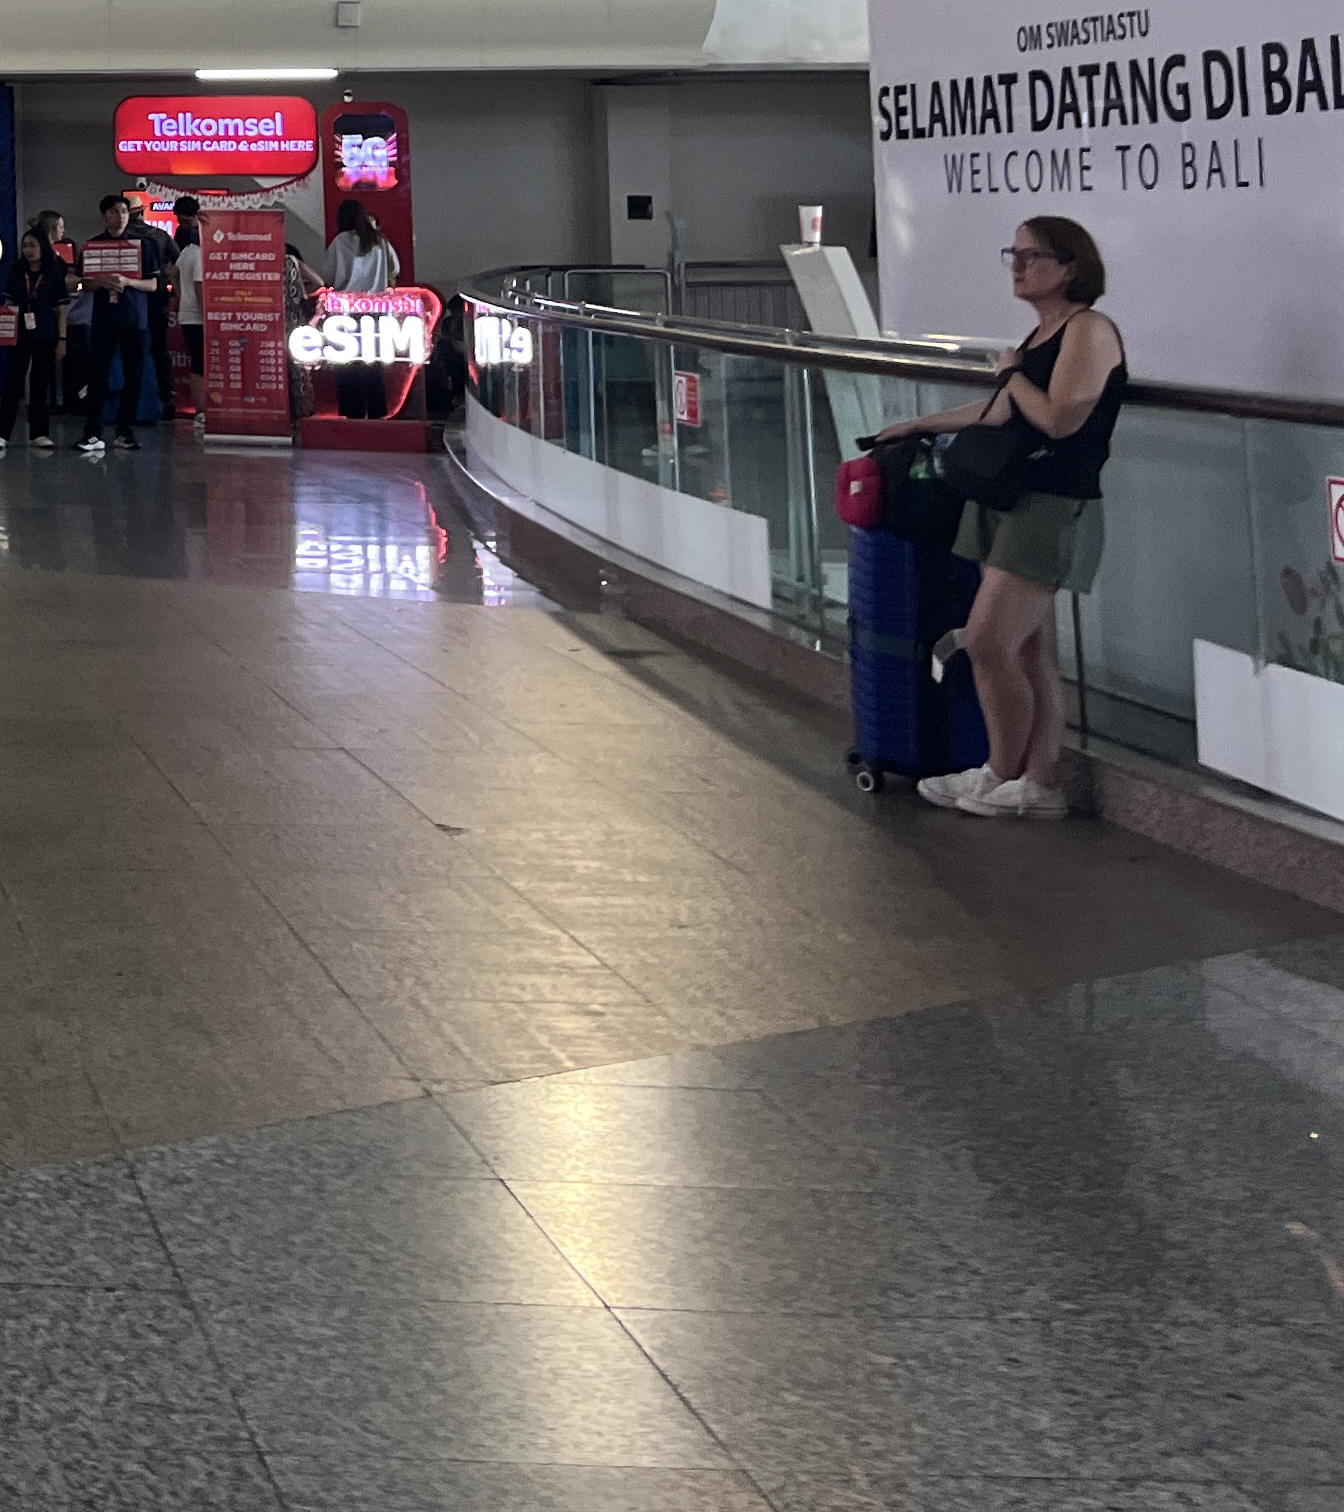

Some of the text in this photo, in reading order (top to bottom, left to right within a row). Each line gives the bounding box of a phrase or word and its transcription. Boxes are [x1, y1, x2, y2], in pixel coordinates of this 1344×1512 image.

[1016, 9, 1151, 53] OM SWASTIASTU
[877, 71, 1020, 142] SELAMAT
[1029, 54, 1192, 131] DATANG
[1202, 46, 1250, 120] DI
[148, 112, 284, 137] Telkomsel
[118, 140, 314, 152] GET YOUR SIM CARD & eSIM HERE
[341, 134, 389, 168] 5G
[944, 137, 1264, 194] WELCOME TO BALI
[226, 232, 272, 242] Telkomsel
[209, 252, 276, 261] GET SIMCARD
[229, 262, 256, 271] HERE
[205, 272, 281, 281] FAST REGISTER
[207, 312, 281, 321] BEST TOURIST
[219, 322, 268, 332] SIMCARD
[288, 314, 426, 364] eSIM
